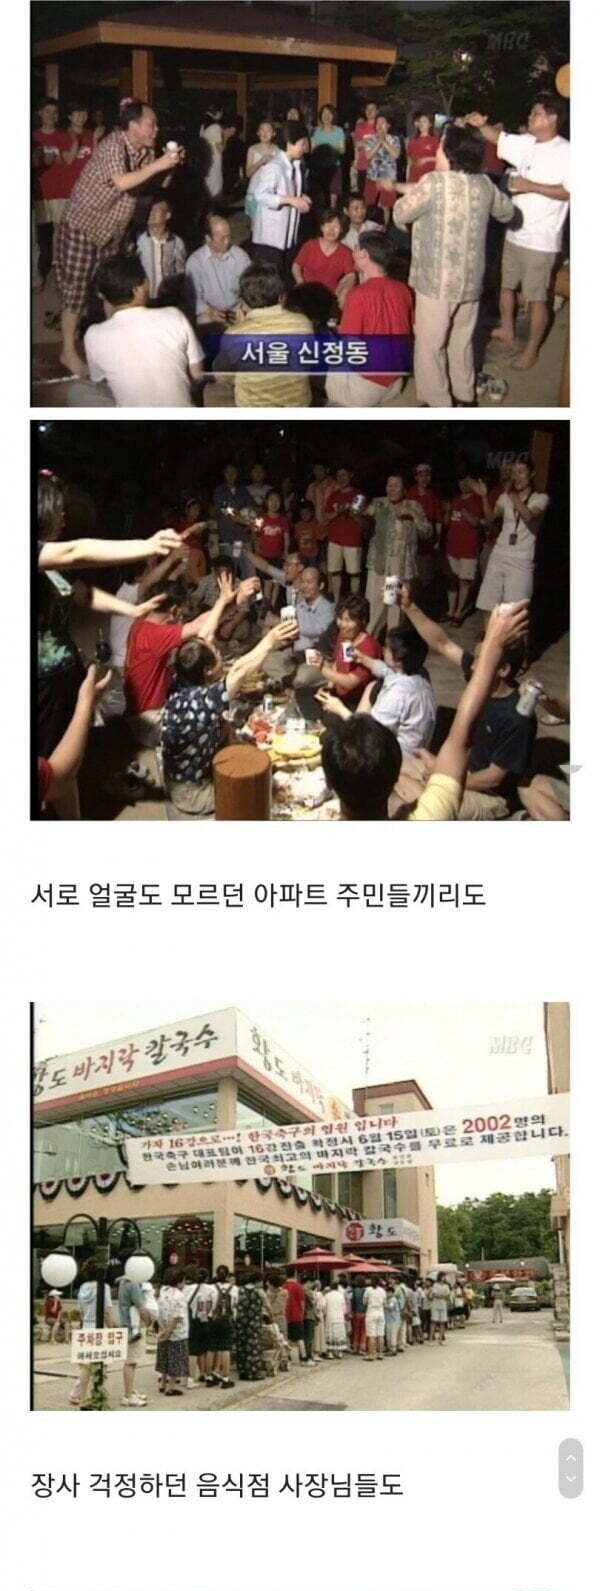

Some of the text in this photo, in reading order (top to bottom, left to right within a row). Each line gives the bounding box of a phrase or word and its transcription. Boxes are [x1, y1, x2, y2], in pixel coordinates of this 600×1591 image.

[72, 1044, 140, 1081] 바지락
[145, 1024, 219, 1065] 칼국수
[142, 1150, 189, 1162] 한국축구
[193, 1146, 244, 1158] 대표팀이
[358, 1132, 382, 1144] 6월
[428, 1136, 474, 1150] 무료로
